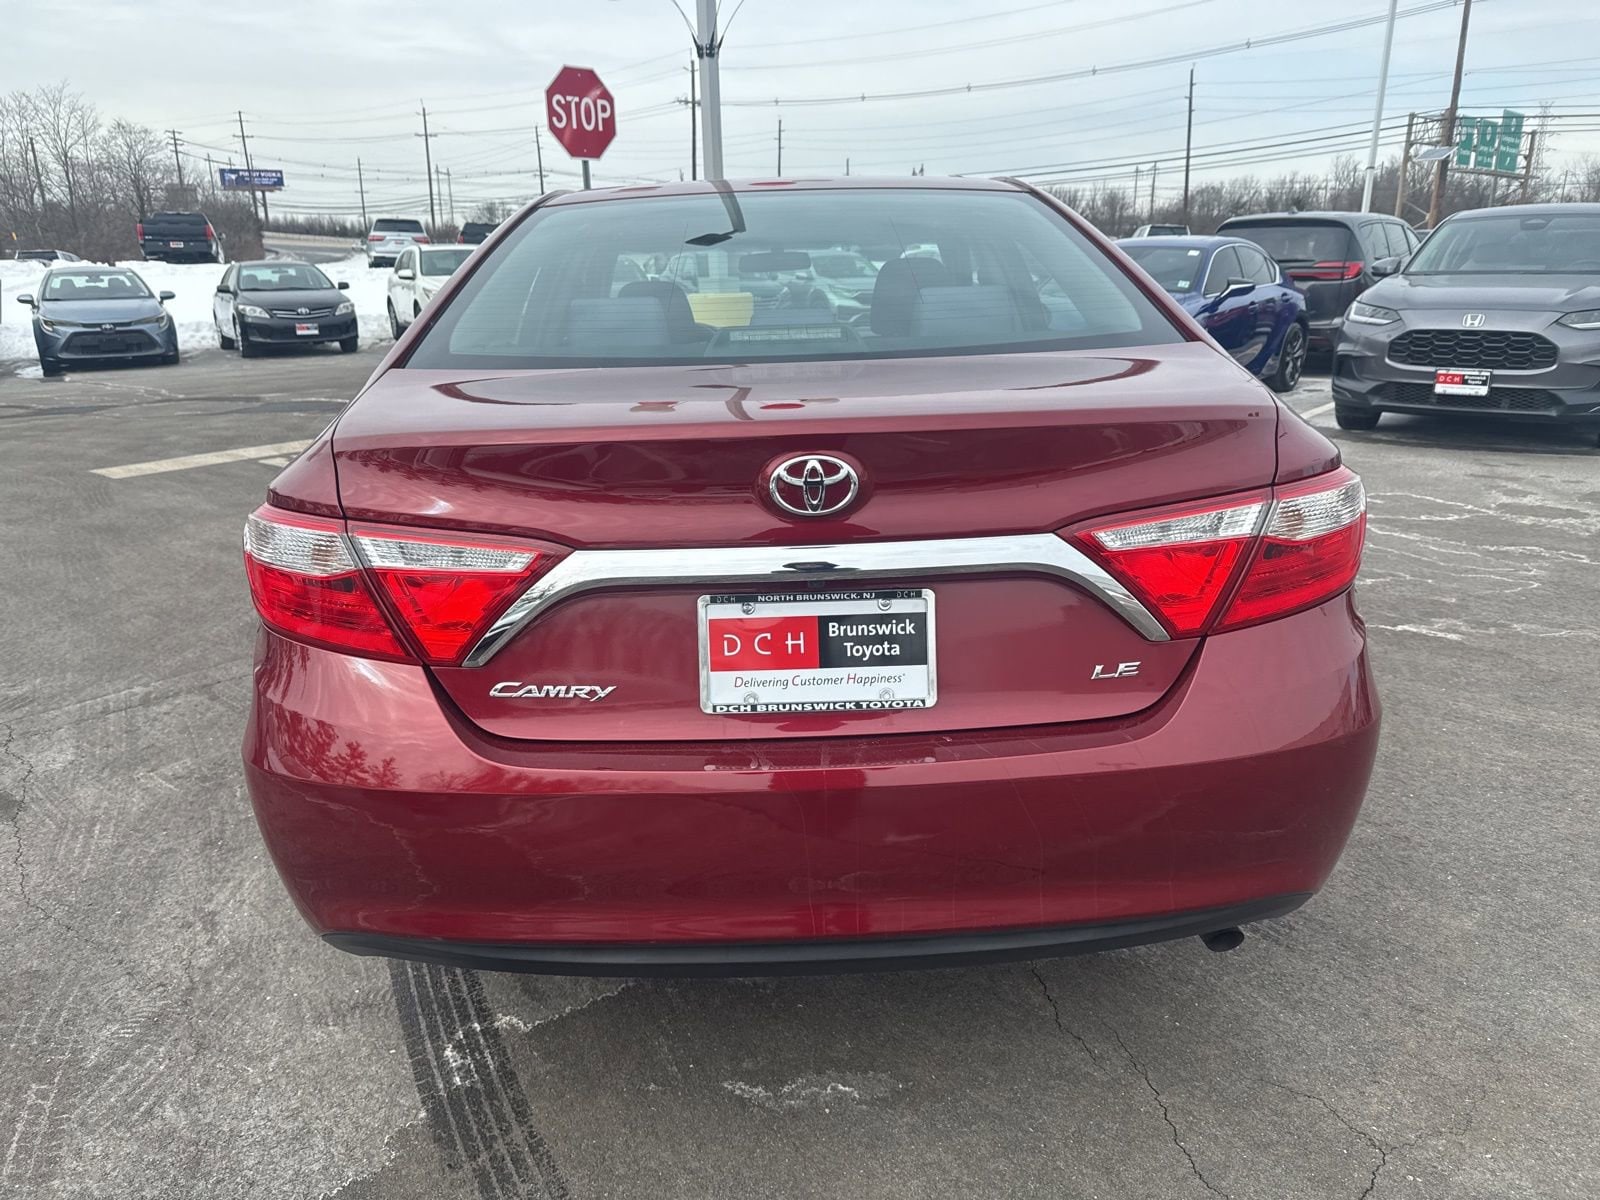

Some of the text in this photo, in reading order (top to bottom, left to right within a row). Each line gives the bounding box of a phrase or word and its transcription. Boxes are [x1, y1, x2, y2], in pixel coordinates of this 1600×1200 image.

[552, 93, 611, 132] STOP
[757, 594, 794, 602] NORTH
[828, 618, 916, 637] Brunswick
[843, 641, 901, 661] Toyota
[1090, 661, 1142, 680] LE
[489, 681, 617, 702] CAMRY
[734, 676, 789, 690] Delivering
[791, 674, 844, 687] Customer
[716, 699, 924, 713] DCH BRUNSWICK TOYOTA
